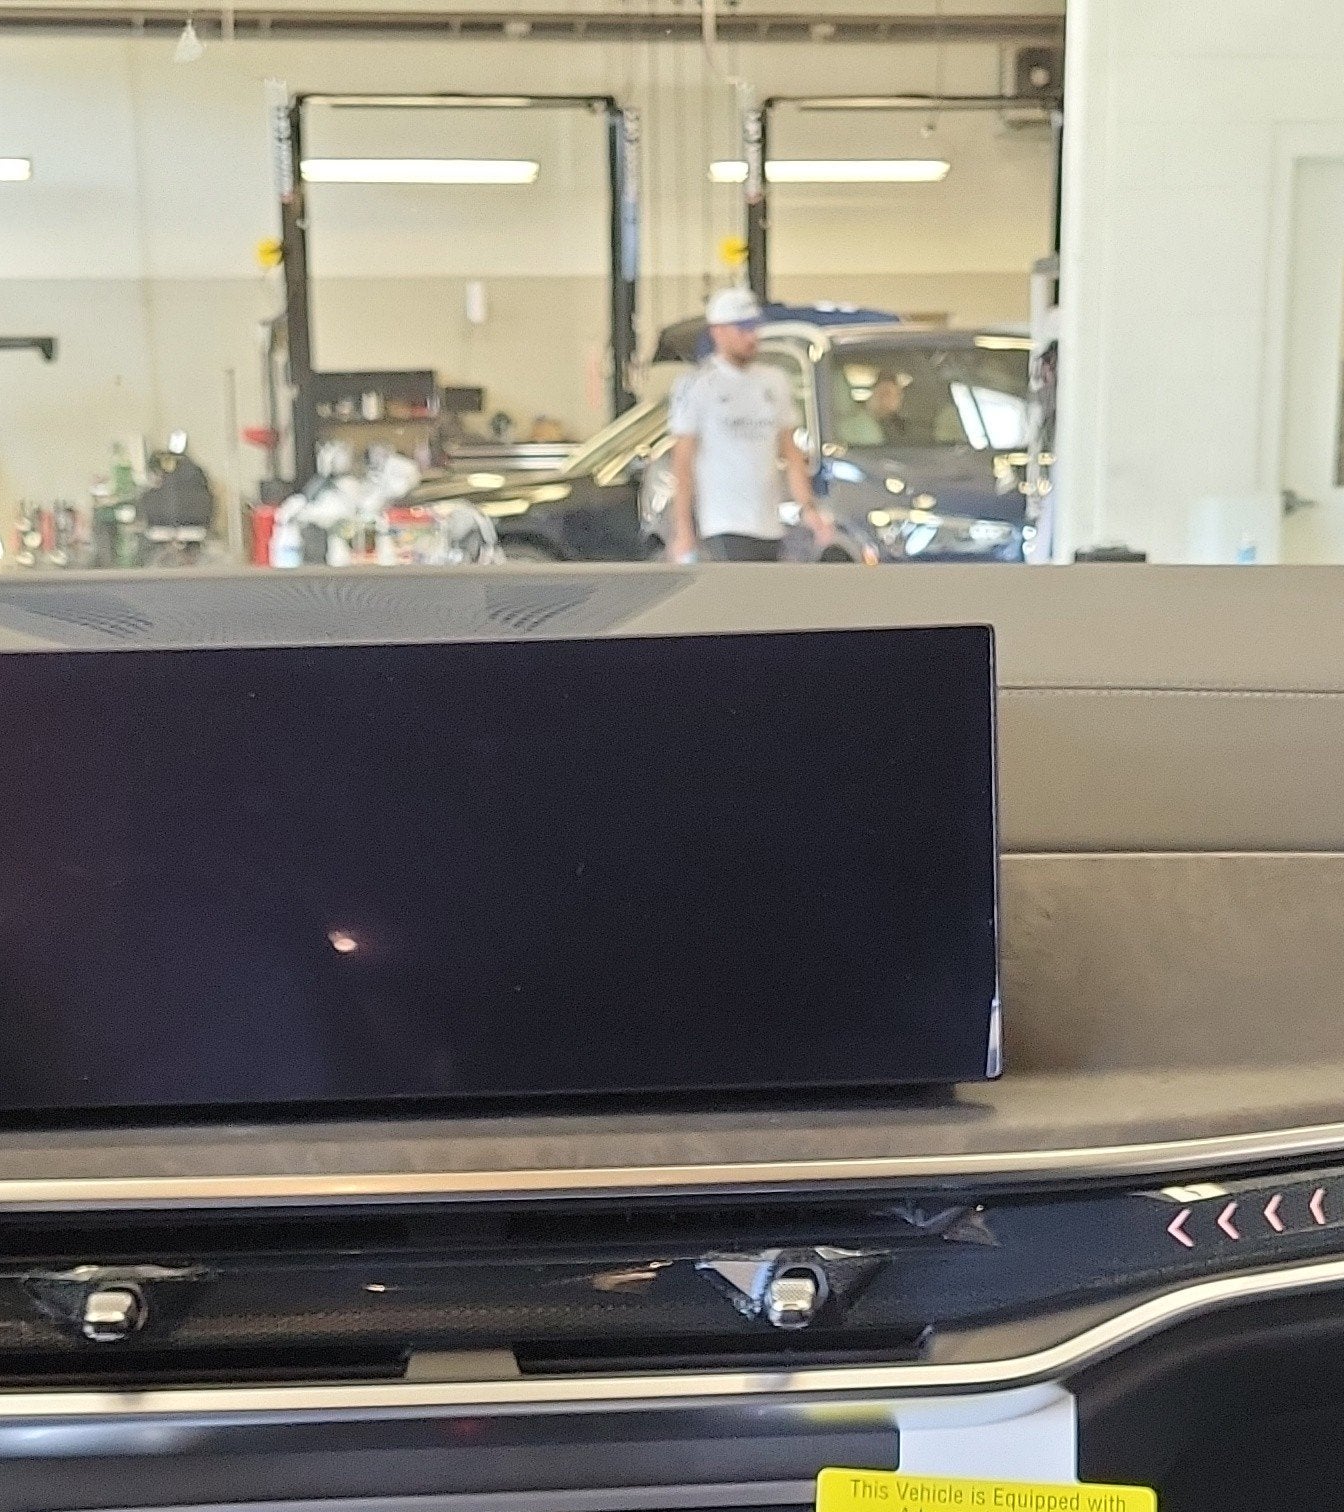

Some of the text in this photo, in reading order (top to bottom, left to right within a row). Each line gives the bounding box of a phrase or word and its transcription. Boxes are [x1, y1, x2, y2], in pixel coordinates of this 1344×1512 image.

[850, 1479, 888, 1500] This
[896, 1481, 963, 1504] Vehicle
[971, 1485, 985, 1505] is
[994, 1487, 1080, 1512] Equipped
